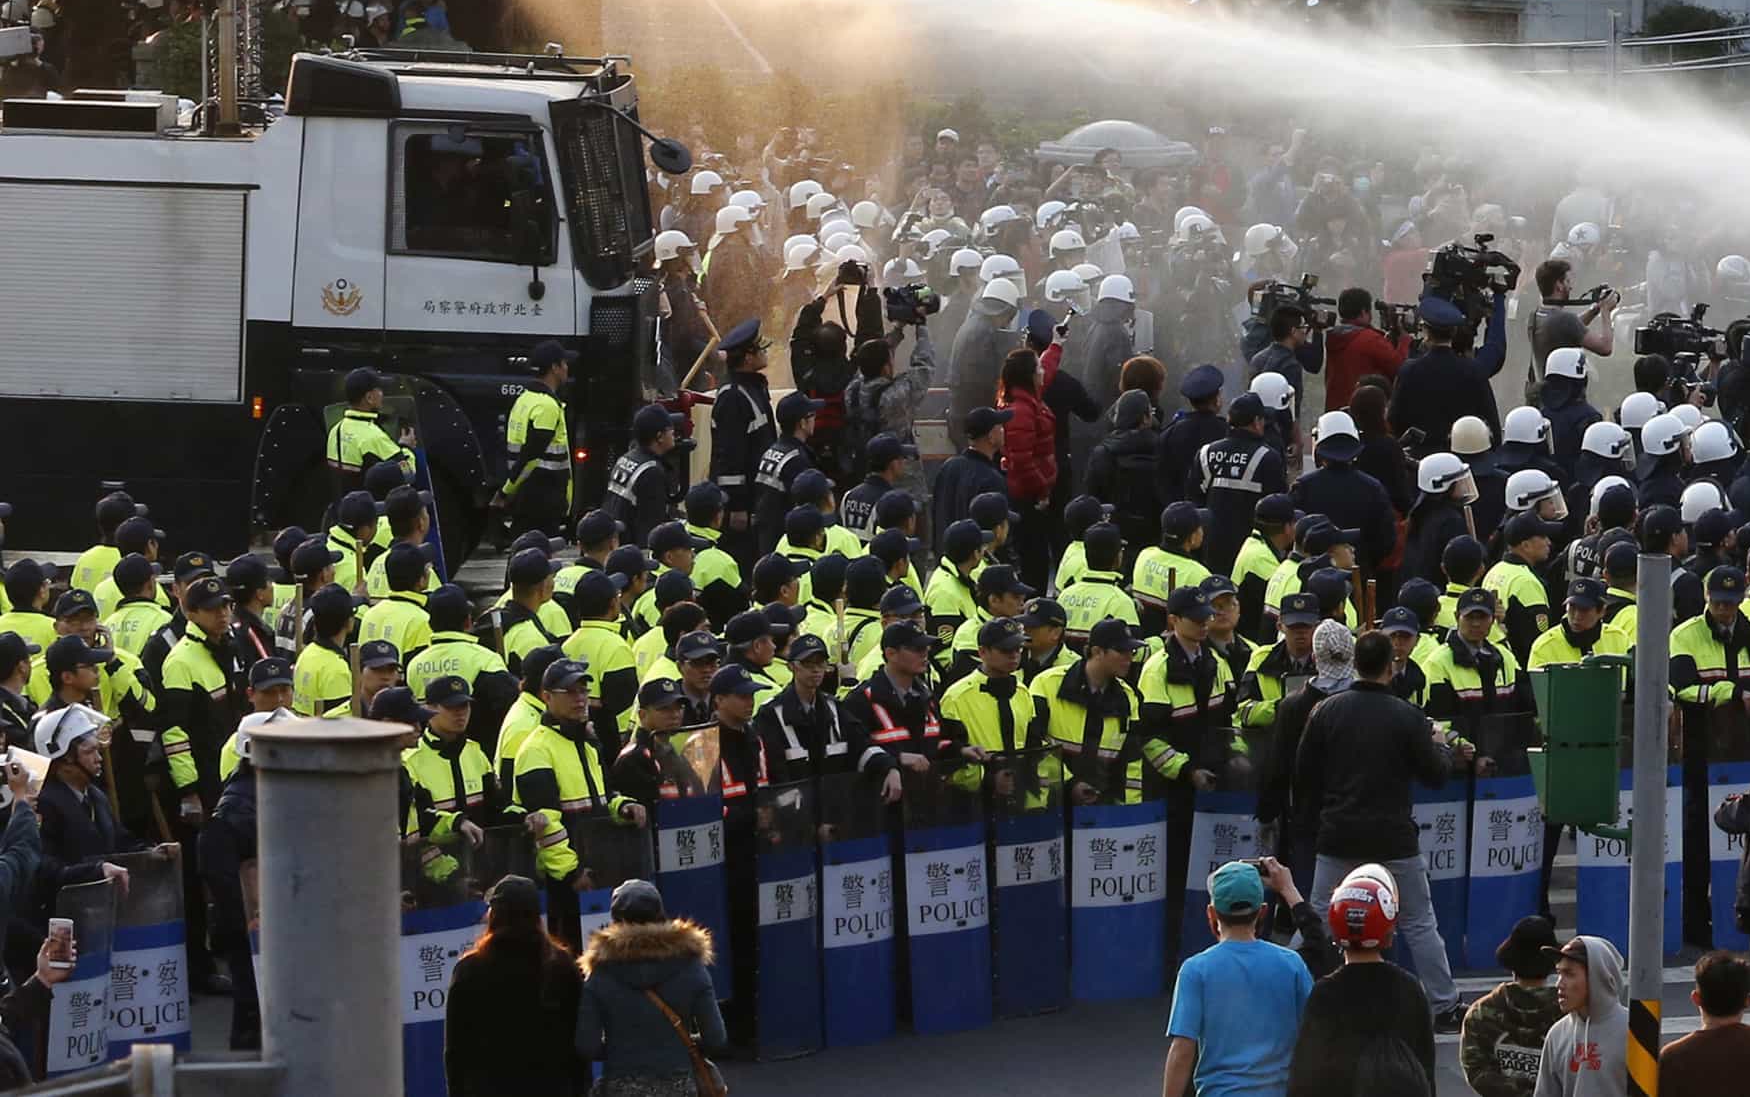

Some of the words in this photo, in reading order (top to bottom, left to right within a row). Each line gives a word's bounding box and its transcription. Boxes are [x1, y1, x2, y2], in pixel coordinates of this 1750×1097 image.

[1209, 451, 1248, 464] POLICE
[416, 659, 459, 675] POLICE
[1435, 811, 1457, 844] 察
[1488, 807, 1541, 841] 警察
[1089, 834, 1157, 871] 警察
[1488, 842, 1539, 867] POLICE
[927, 857, 981, 898] 警察
[1090, 872, 1157, 898] POLICE
[920, 896, 985, 924] POLICE
[111, 958, 178, 1001] 警察
[110, 1000, 186, 1029] OLICE
